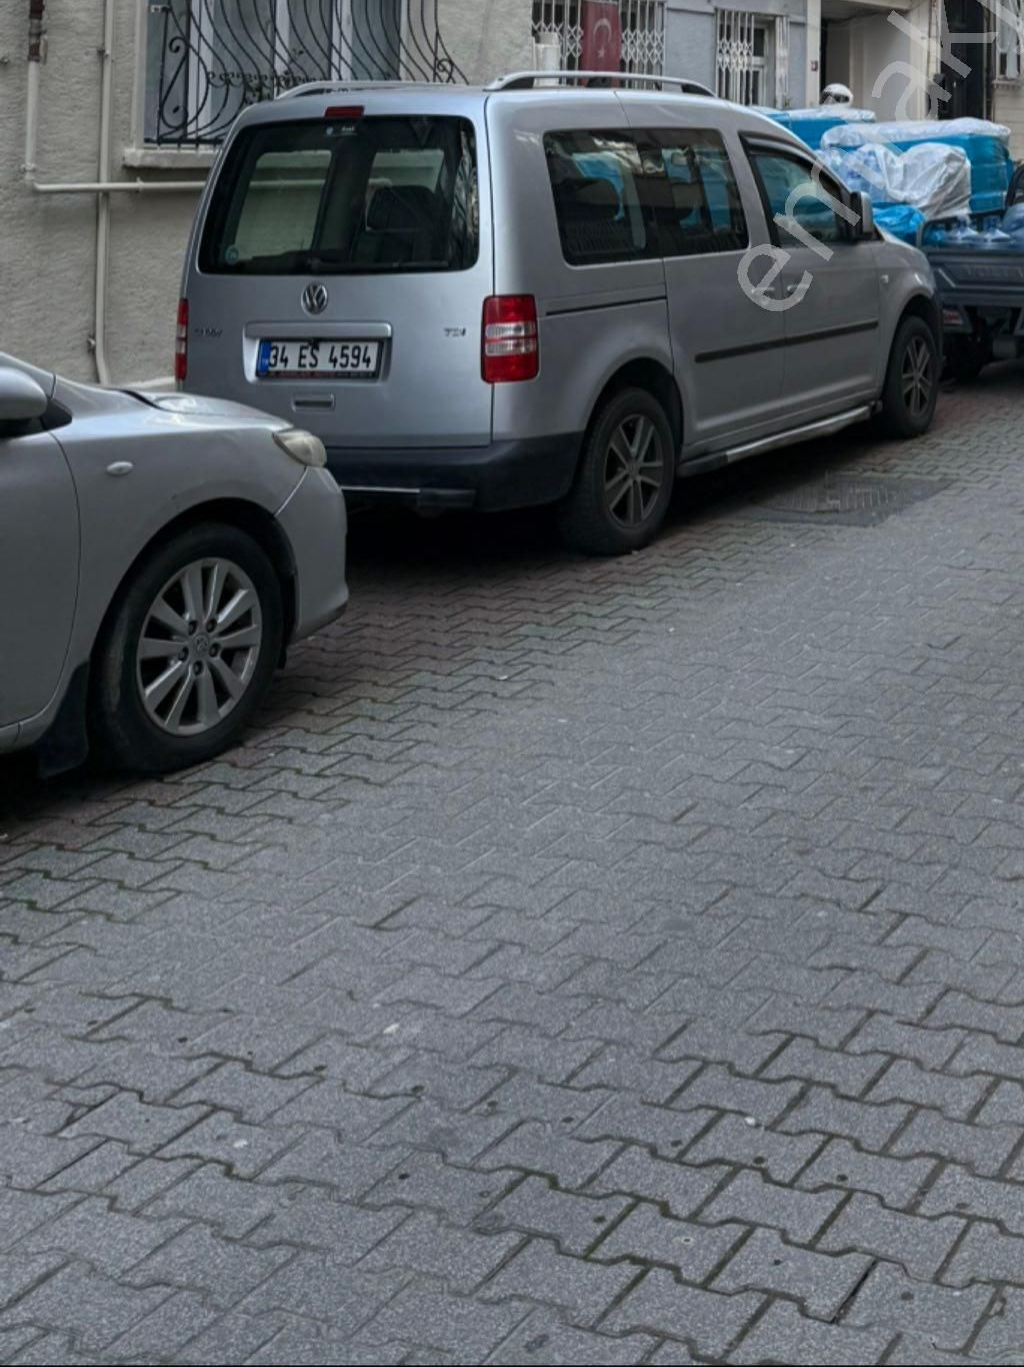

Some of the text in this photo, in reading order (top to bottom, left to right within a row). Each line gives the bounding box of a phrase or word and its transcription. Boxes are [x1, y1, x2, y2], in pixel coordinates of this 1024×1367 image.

[268, 345, 371, 369] 34 ES 4594
